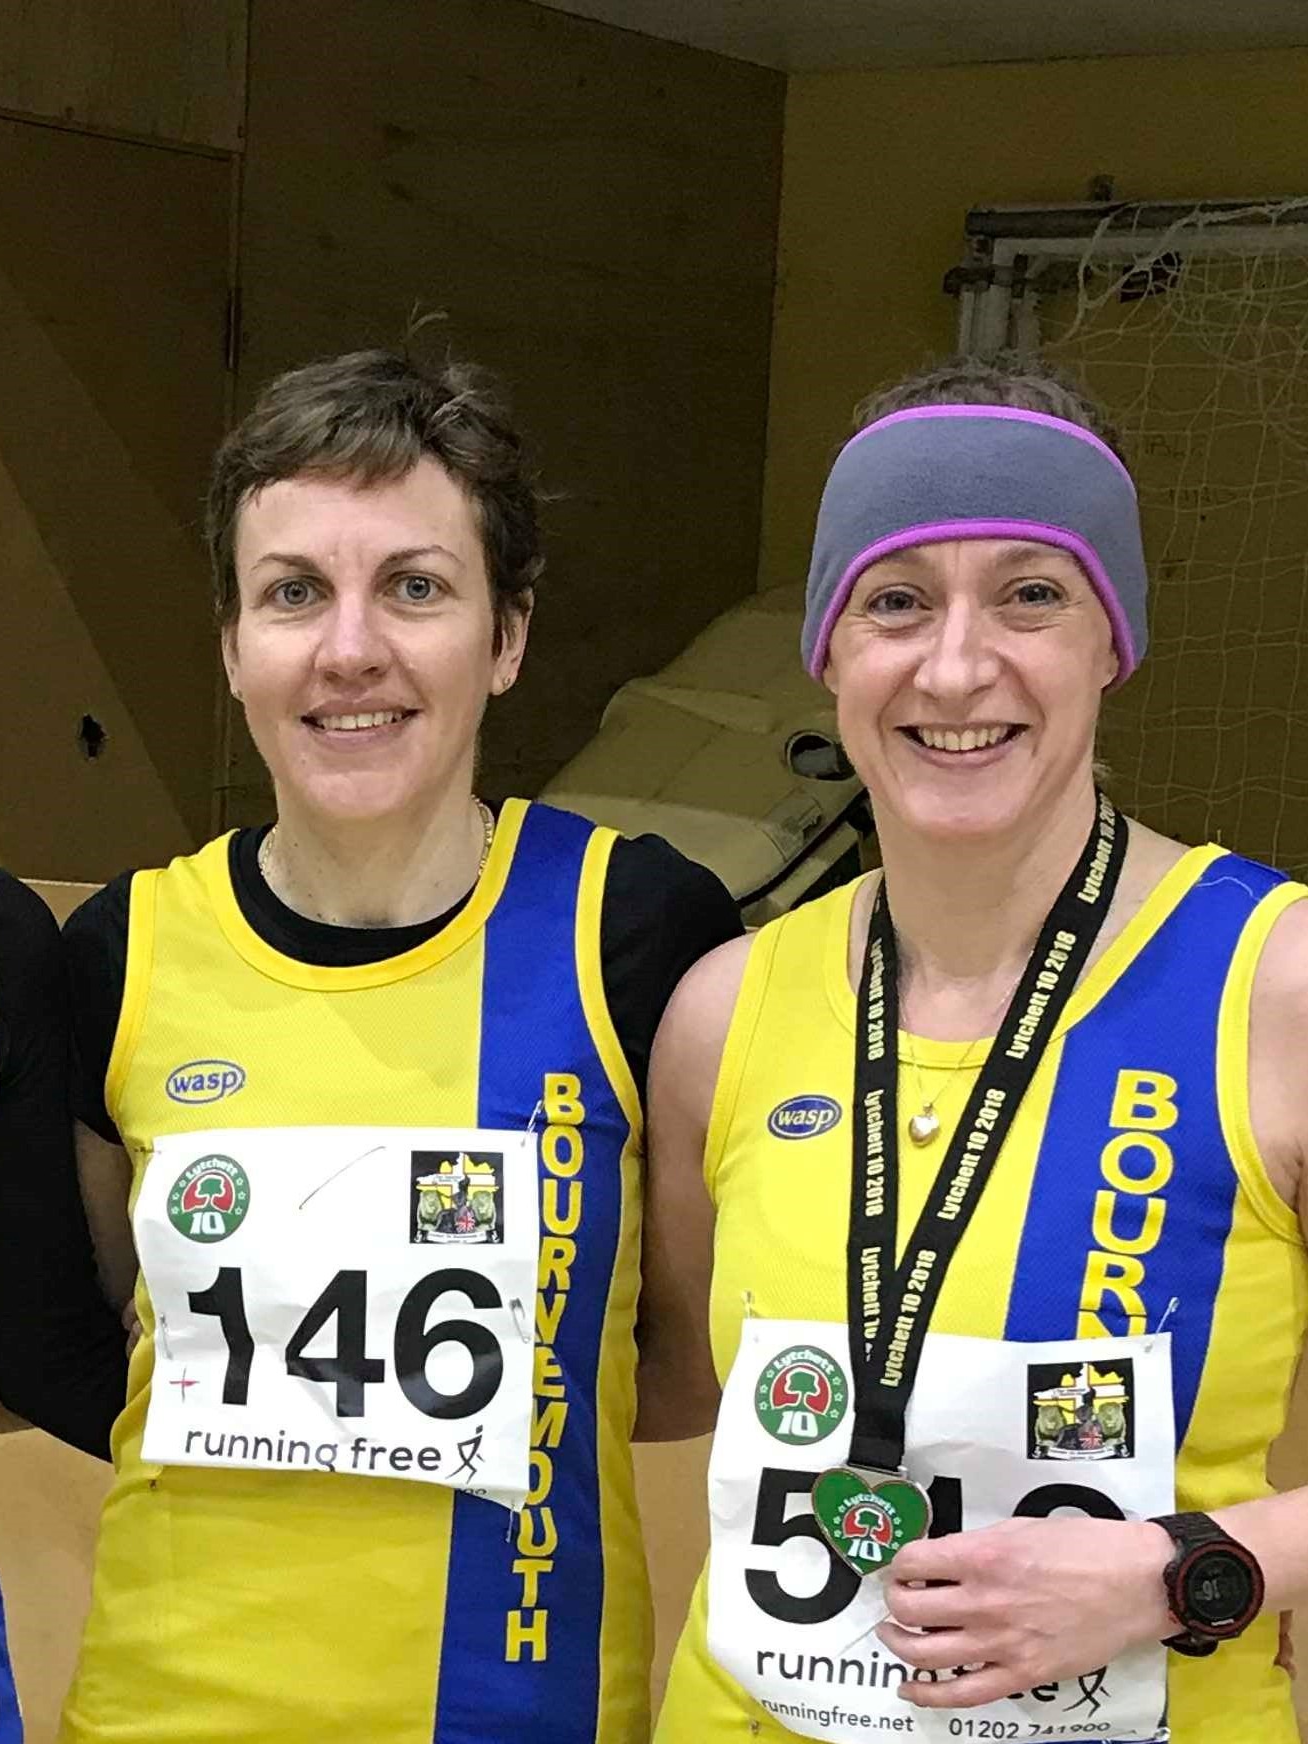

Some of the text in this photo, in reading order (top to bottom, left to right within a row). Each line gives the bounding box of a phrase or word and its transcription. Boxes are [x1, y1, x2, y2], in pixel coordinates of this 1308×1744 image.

[1005, 930, 1077, 1060] Lytchett 10 2018
[868, 1020, 885, 1061] 2018
[173, 1071, 238, 1096] wasp
[777, 1109, 834, 1131] wasp
[185, 1158, 239, 1180] Lytchett
[864, 1089, 884, 1217] Lytchett 10 2018
[936, 1088, 1006, 1220] Lytchett 10 2018
[190, 1211, 226, 1235] 10
[860, 1246, 881, 1317] Lytchett
[879, 1249, 937, 1388] Lytchett 10 2018
[186, 1266, 504, 1420] 146
[773, 1350, 835, 1375] Lytchett
[776, 1411, 819, 1438] 10
[185, 1430, 442, 1472] running free
[847, 1538, 883, 1562] 10
[761, 1699, 1111, 1739] runningfree.net 01202 741900
